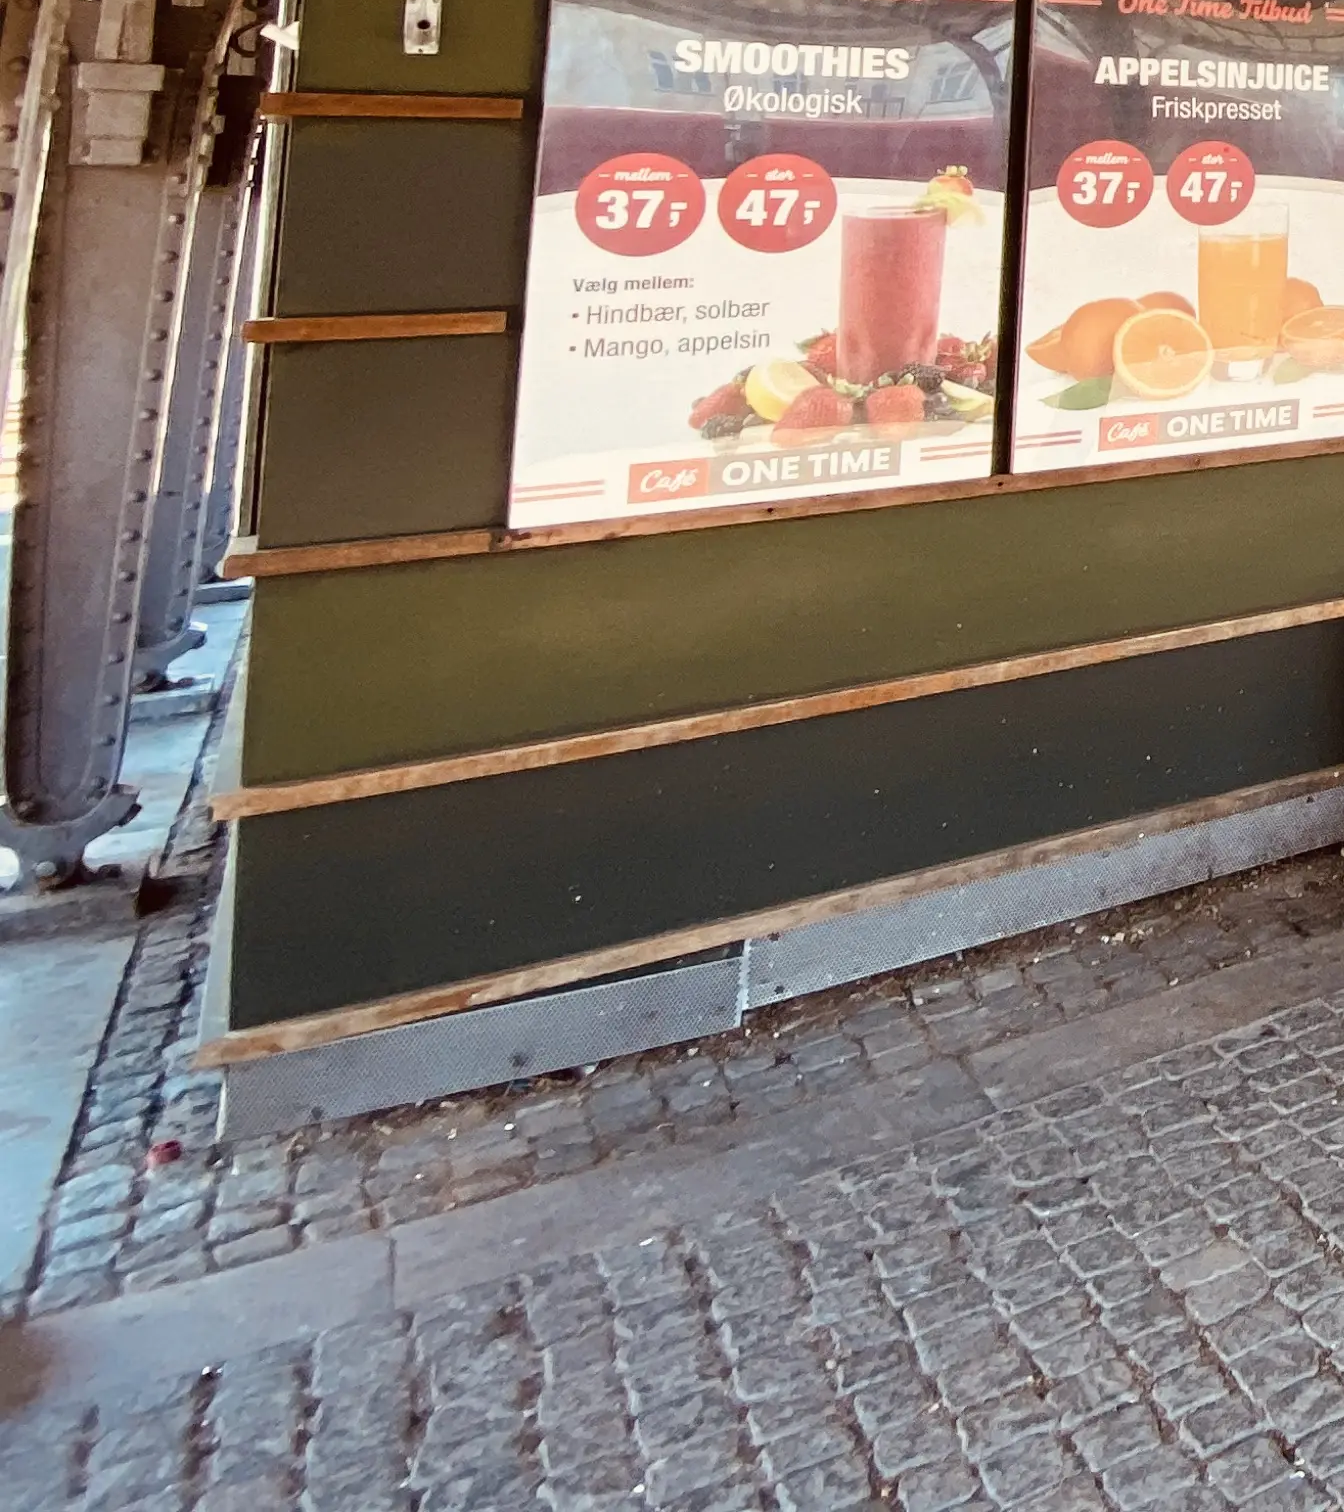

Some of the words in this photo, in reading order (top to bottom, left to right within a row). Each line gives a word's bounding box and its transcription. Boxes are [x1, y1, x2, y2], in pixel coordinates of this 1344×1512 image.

[674, 39, 911, 81] SMOOTHIES
[1094, 56, 1330, 91] APPELSINJUICE
[723, 85, 864, 118] Økologisk
[1152, 96, 1282, 123] Friskpresset
[573, 277, 618, 294] Vælg
[624, 275, 695, 291] mellem:
[586, 303, 688, 325] Hindbær,
[695, 300, 770, 320] solbær
[584, 337, 670, 359] Mango,
[677, 330, 771, 355] appelsin
[1167, 412, 1225, 438] ONE
[1229, 405, 1292, 431] TIME
[640, 467, 699, 493] Café
[721, 455, 801, 485] ONE
[807, 447, 892, 477] TIME
